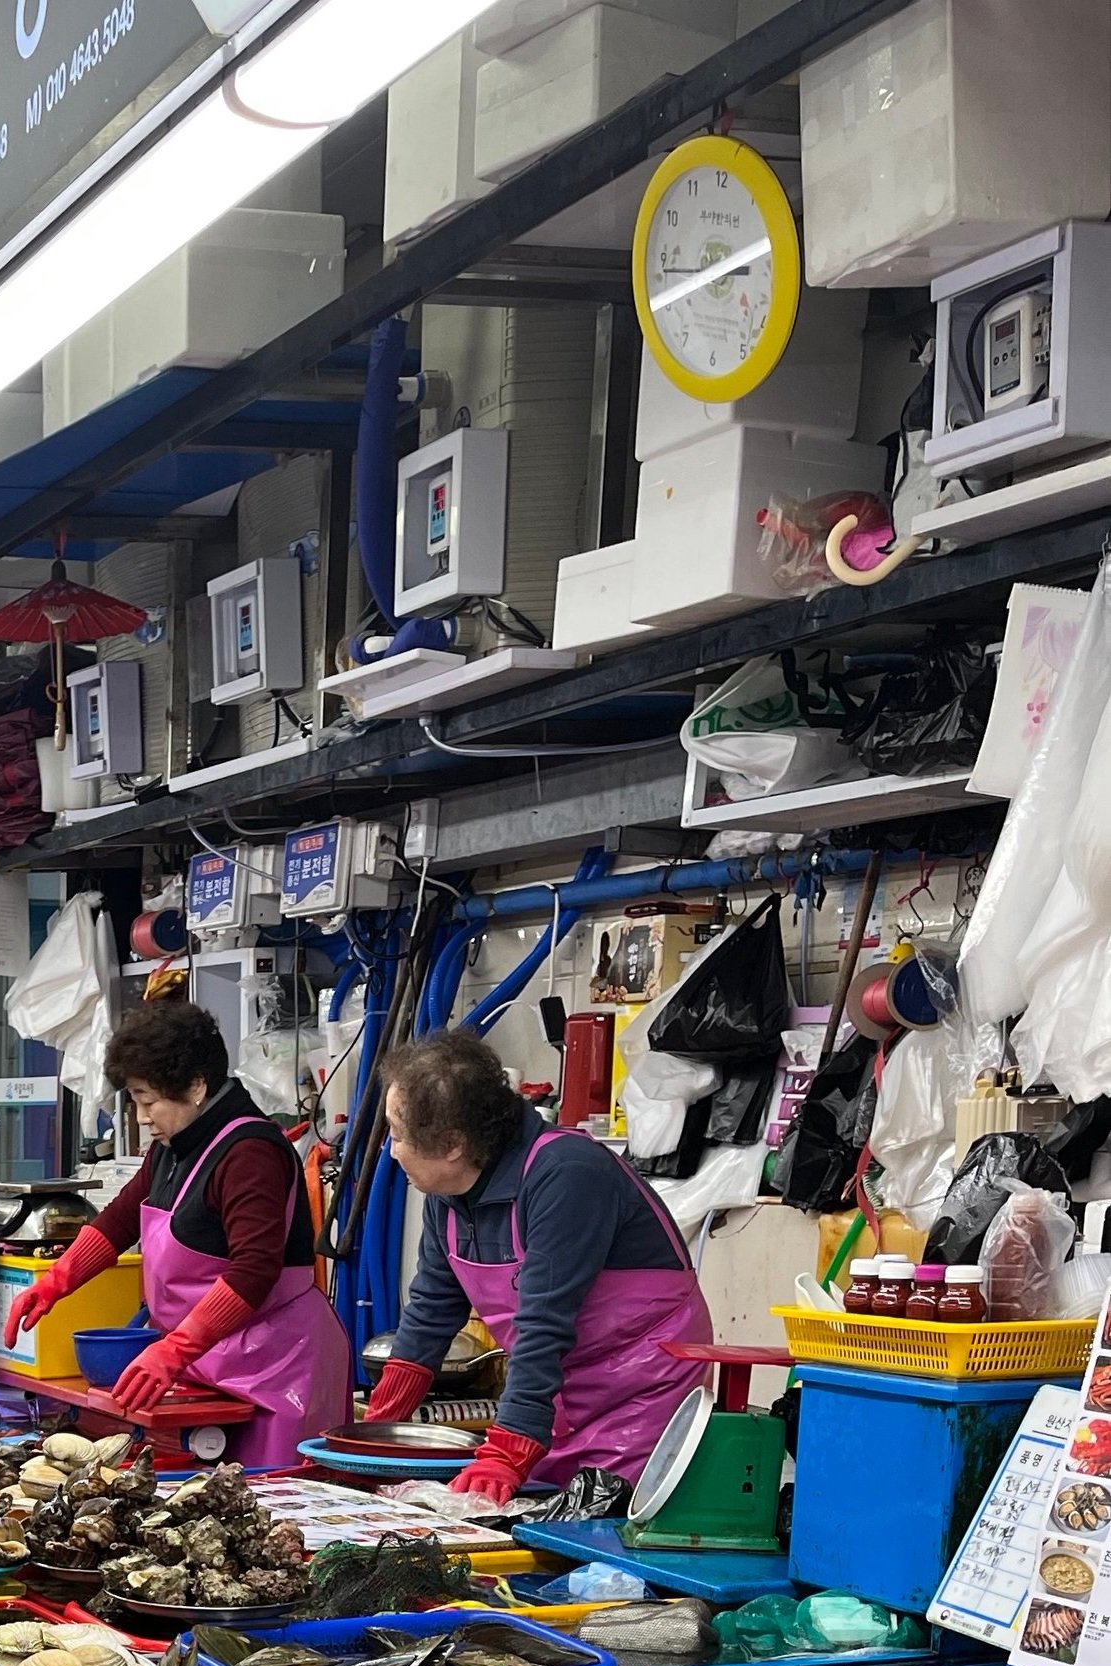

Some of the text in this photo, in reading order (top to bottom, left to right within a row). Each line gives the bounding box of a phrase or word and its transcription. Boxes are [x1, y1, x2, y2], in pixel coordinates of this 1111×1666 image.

[26, 84, 42, 133] M)
[46, 62, 66, 111] 010
[69, 0, 135, 86] 4643.5048
[715, 171, 728, 188] 12
[687, 180, 699, 197] 11
[667, 210, 678, 227] 10
[660, 252, 667, 269] 9
[681, 332, 689, 347] 7
[709, 351, 716, 367] 6
[740, 344, 747, 360] 5
[301, 854, 331, 879] 분전함
